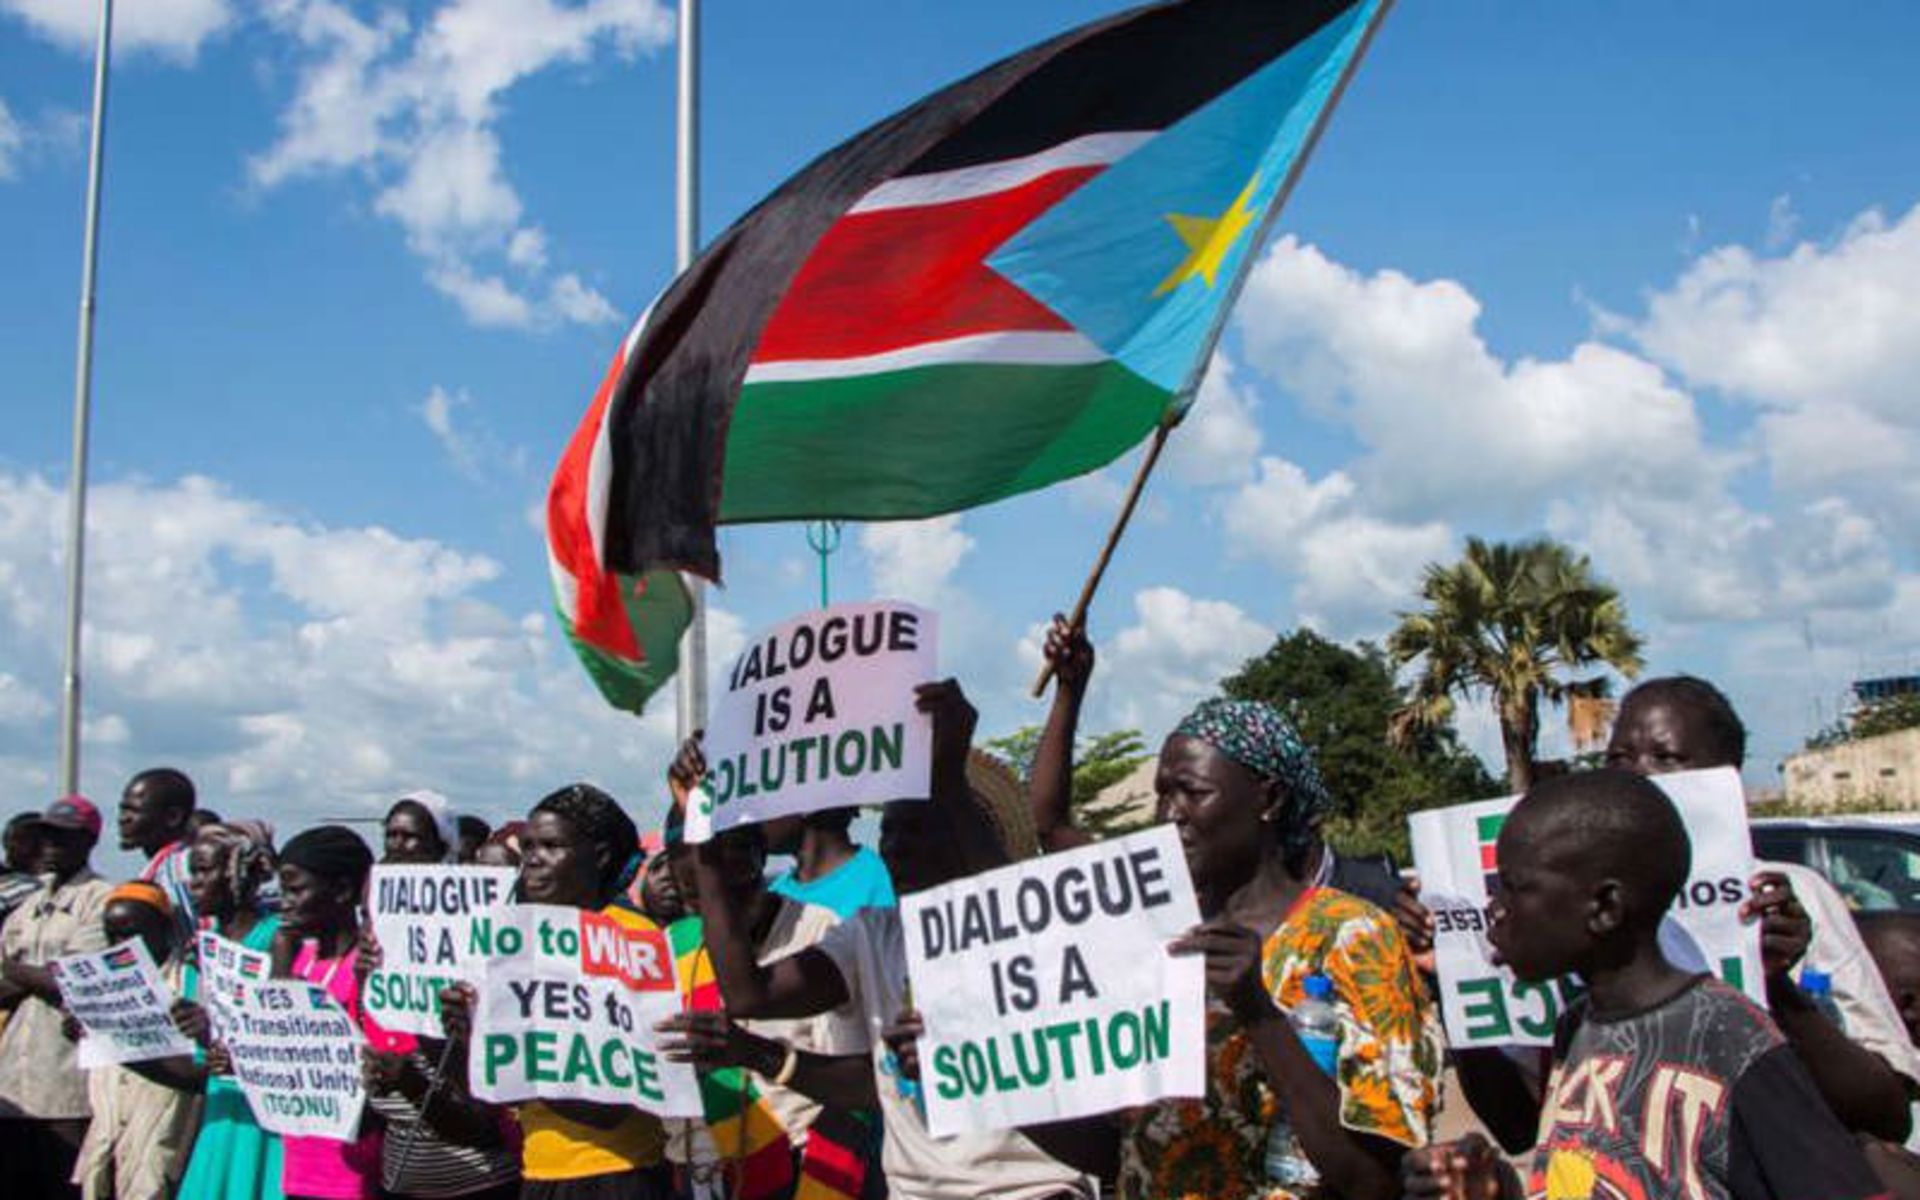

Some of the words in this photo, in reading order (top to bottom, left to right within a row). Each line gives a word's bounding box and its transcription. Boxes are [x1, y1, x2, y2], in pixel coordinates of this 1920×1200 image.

[730, 612, 918, 691] IALOGUE
[754, 687, 792, 736] IS
[805, 677, 835, 723] A
[700, 723, 904, 815] SOLUTION
[920, 847, 1171, 960] DIALOGUE
[408, 925, 427, 964] IS
[436, 928, 456, 966] A
[468, 918, 522, 956] No
[538, 919, 579, 957] to
[585, 923, 663, 981] WAR
[255, 988, 294, 1009] YES
[369, 972, 451, 1014] SOLUT
[509, 981, 591, 1022] YES
[605, 991, 633, 1032] to
[991, 955, 1039, 1016] IS
[1060, 945, 1098, 1004] A
[484, 1032, 665, 1102] PEACE
[933, 1000, 1170, 1100] SOLUTION
